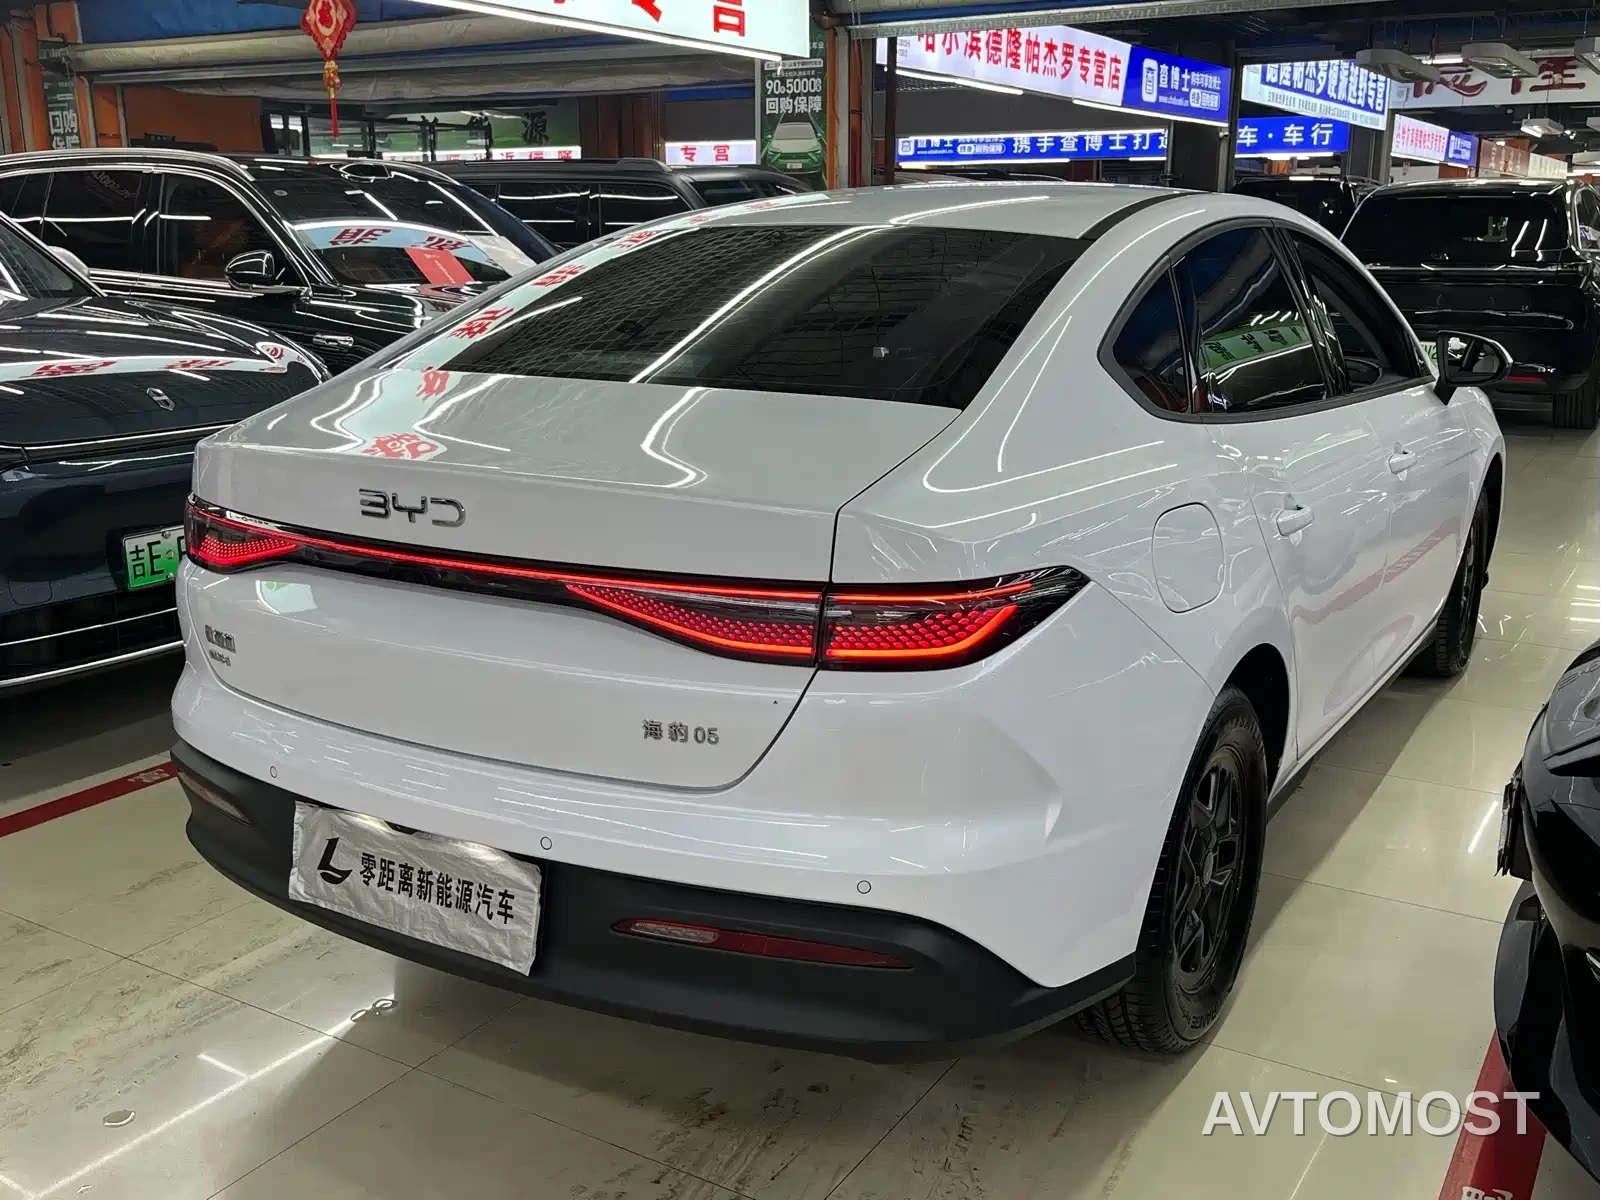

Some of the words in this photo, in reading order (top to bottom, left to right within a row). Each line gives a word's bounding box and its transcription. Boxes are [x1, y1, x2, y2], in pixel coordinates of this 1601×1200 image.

[1159, 63, 1190, 92] 查博士
[765, 95, 822, 115] 回购保障
[49, 109, 78, 135] 回购
[358, 488, 467, 528] BYD
[641, 719, 689, 743] 海豹
[693, 726, 720, 745] 05
[359, 852, 516, 925] 零距离新能源汽车
